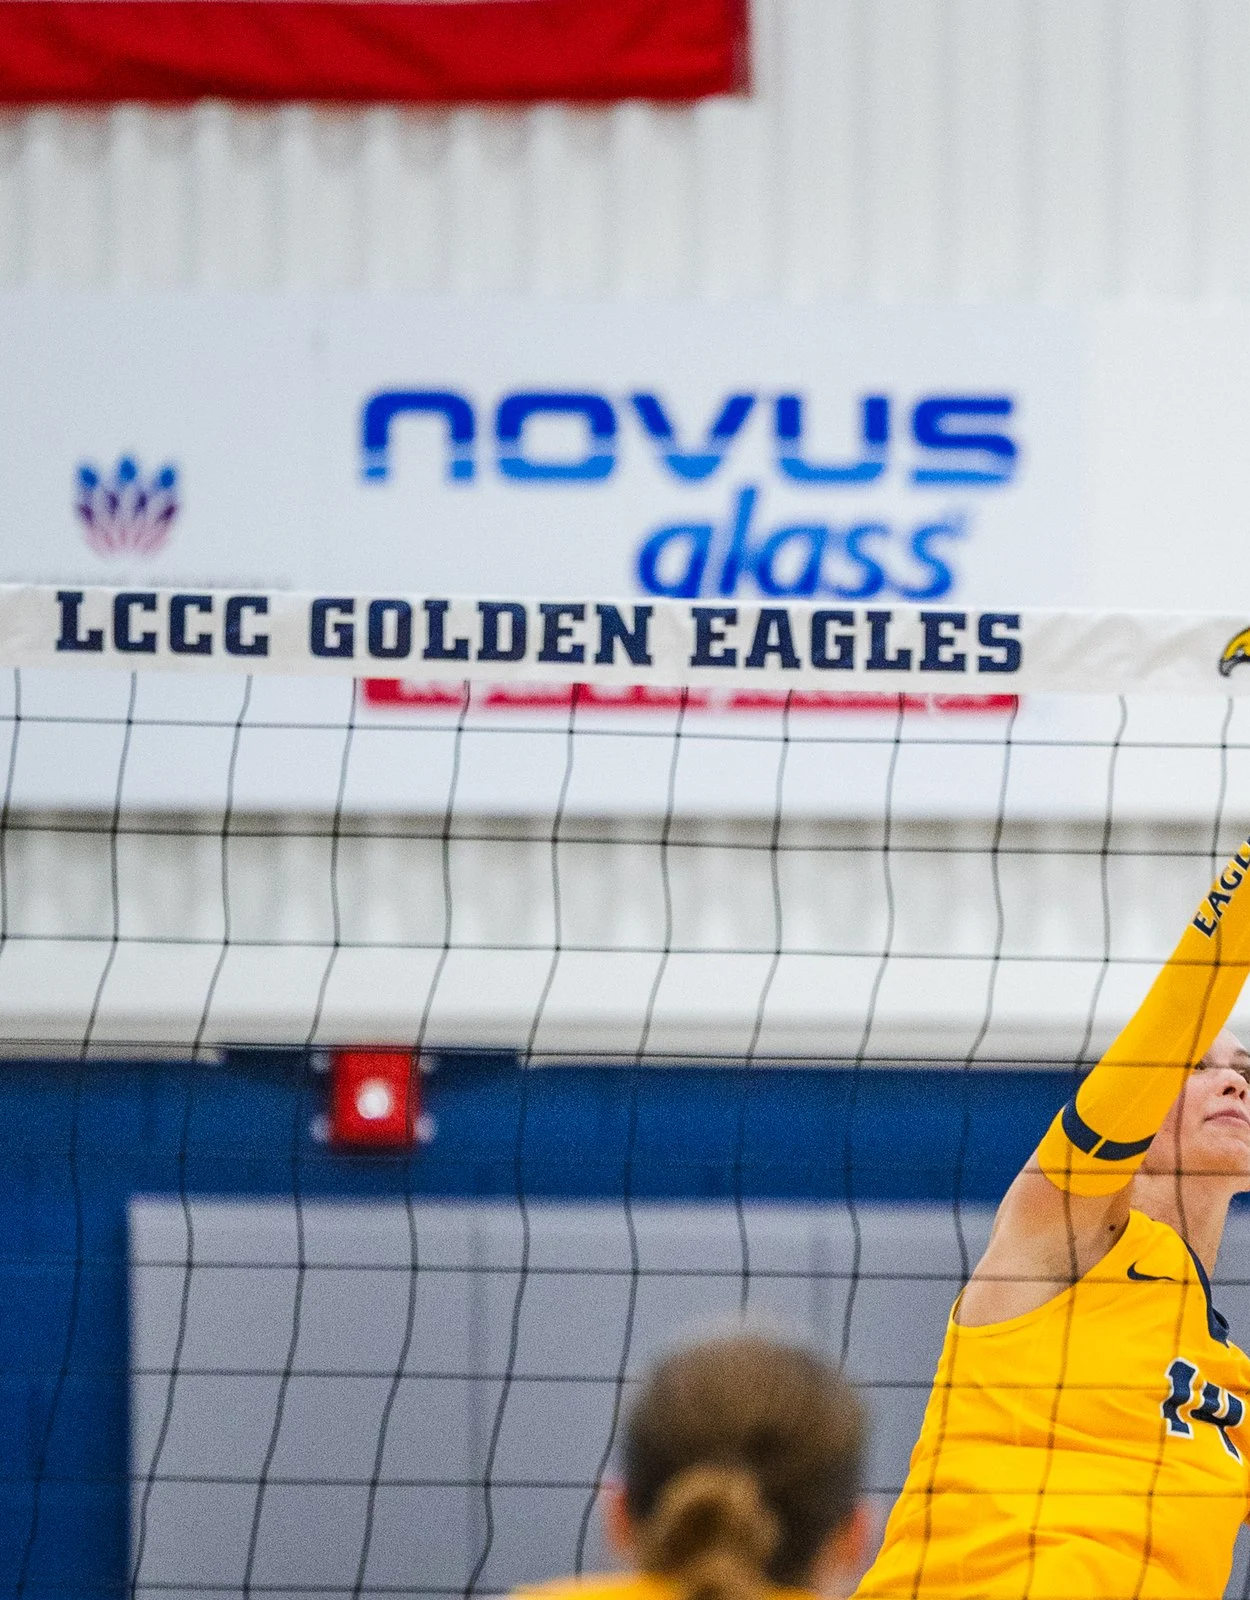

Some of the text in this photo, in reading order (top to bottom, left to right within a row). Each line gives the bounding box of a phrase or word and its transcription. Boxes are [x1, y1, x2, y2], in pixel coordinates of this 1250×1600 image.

[55, 591, 1022, 673] LCCC GOLDEN EAGLES
[1160, 1355, 1245, 1465] 14
